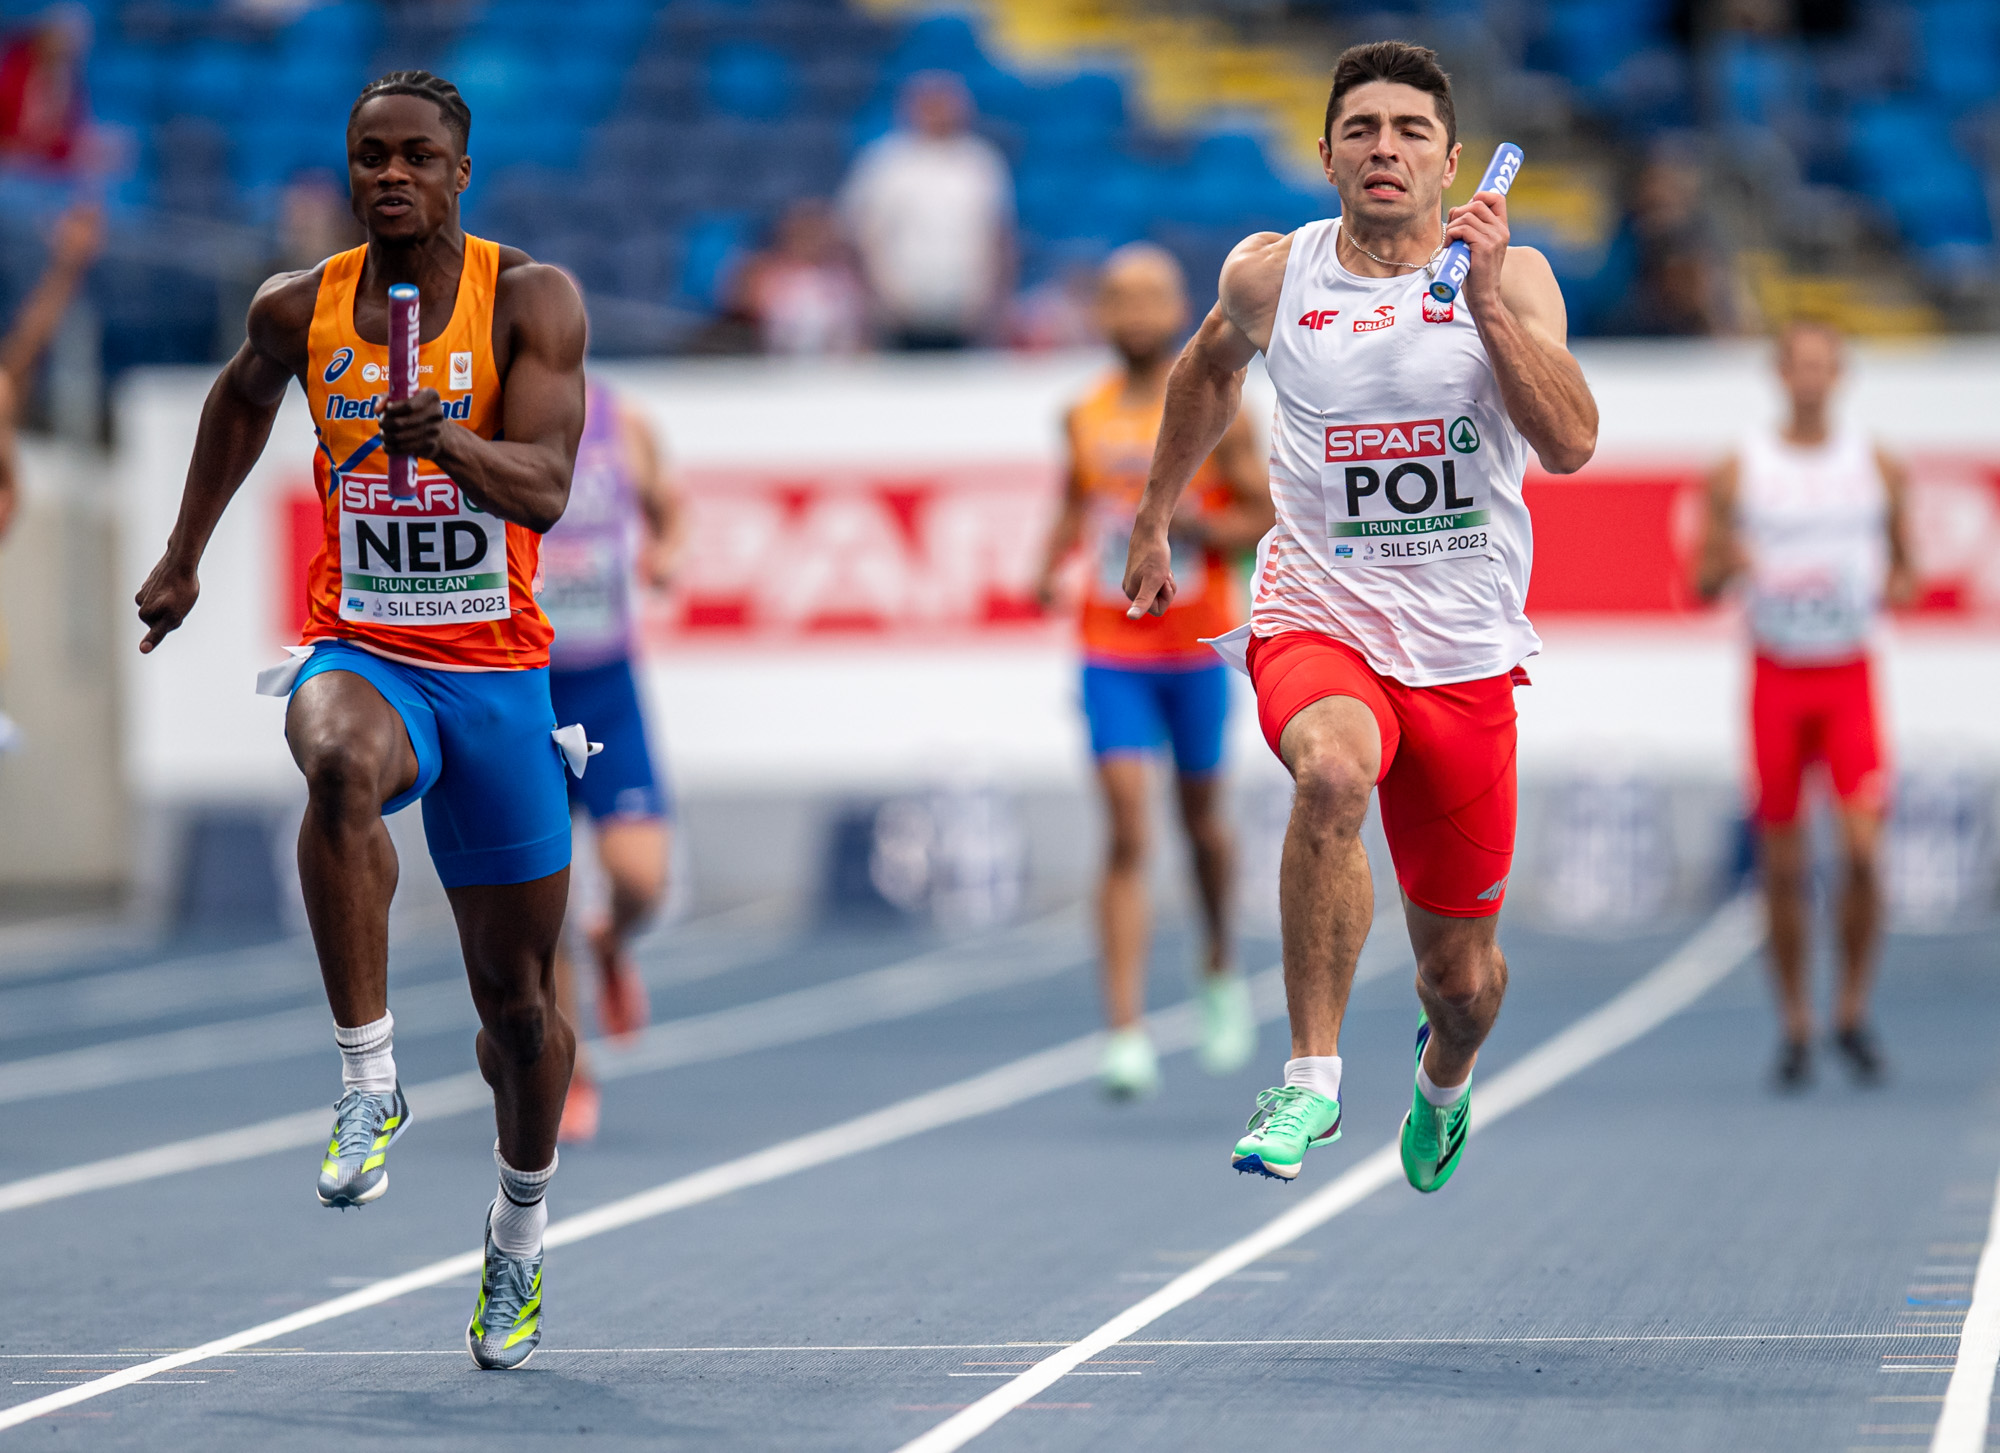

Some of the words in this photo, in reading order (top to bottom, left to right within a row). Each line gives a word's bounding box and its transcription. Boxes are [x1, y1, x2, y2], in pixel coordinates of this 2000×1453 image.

[1298, 310, 1340, 331] 4F
[1355, 318, 1393, 331] ORLEN
[325, 393, 473, 420] Nednd
[1328, 424, 1442, 457] SPAR
[1345, 460, 1474, 517] POL
[1361, 523, 1366, 535] I
[1369, 521, 1402, 534] RUN
[355, 519, 488, 573] NED
[1380, 539, 1444, 557] SILESIA
[1447, 532, 1488, 552] 2023
[372, 578, 376, 590] I
[379, 579, 412, 592] RUN
[388, 600, 457, 617] SILESIA
[461, 596, 505, 614] 2023
